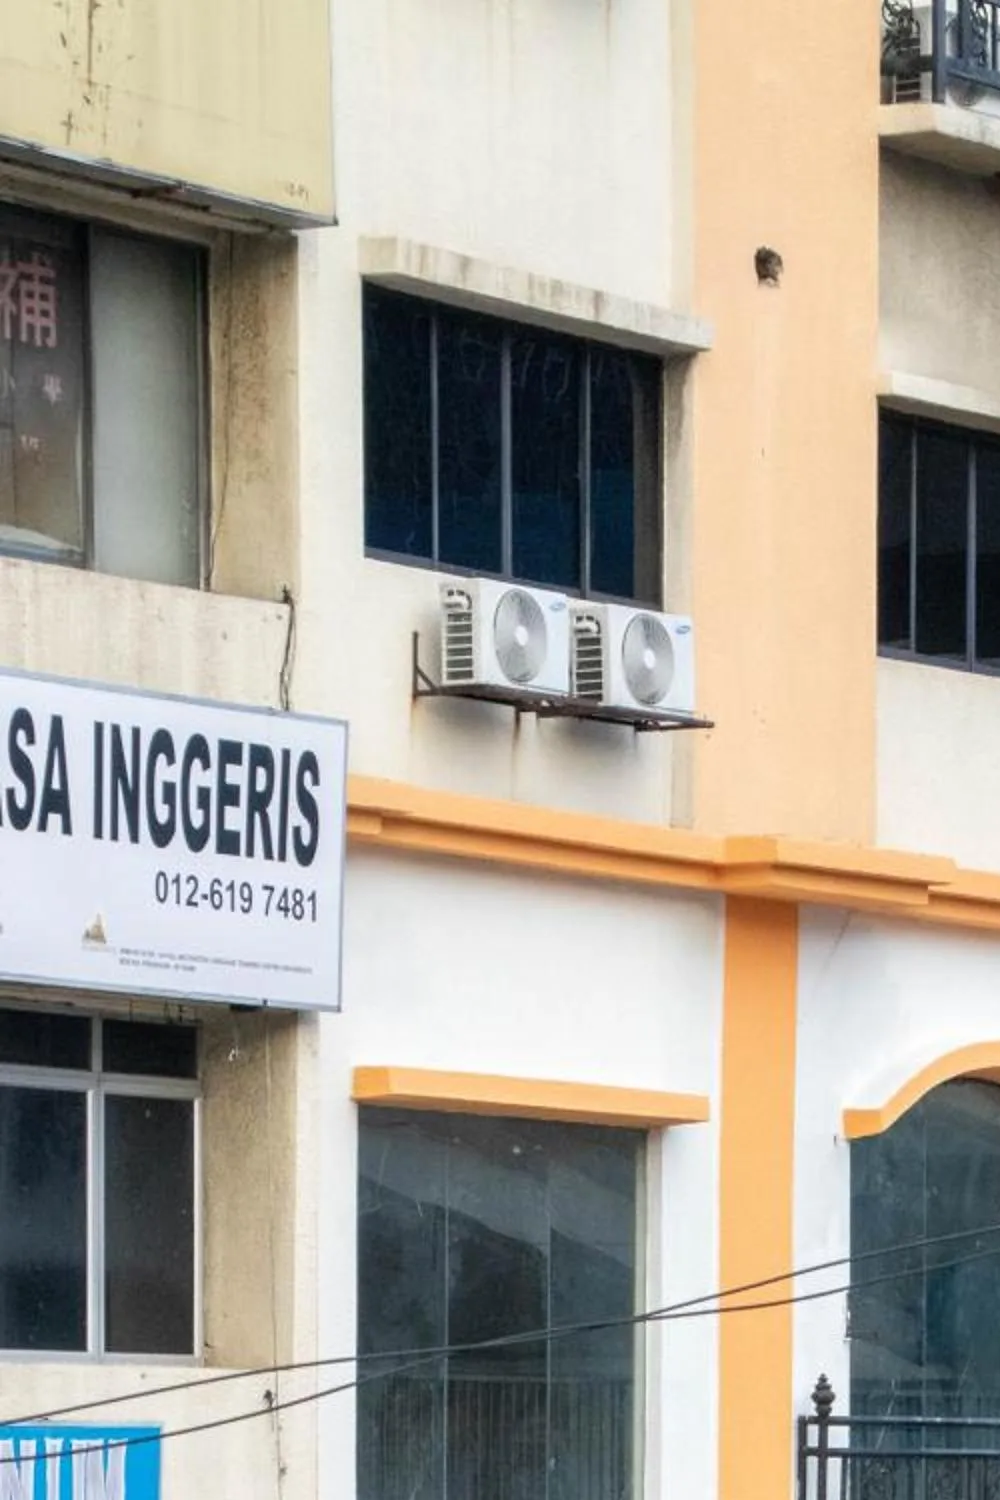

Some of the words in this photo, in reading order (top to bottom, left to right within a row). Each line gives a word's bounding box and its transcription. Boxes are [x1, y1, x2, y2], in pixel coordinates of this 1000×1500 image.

[0, 707, 72, 836] SA
[93, 720, 321, 867] INGGERIS
[155, 870, 253, 914] 012-619
[262, 885, 318, 923] 7481
